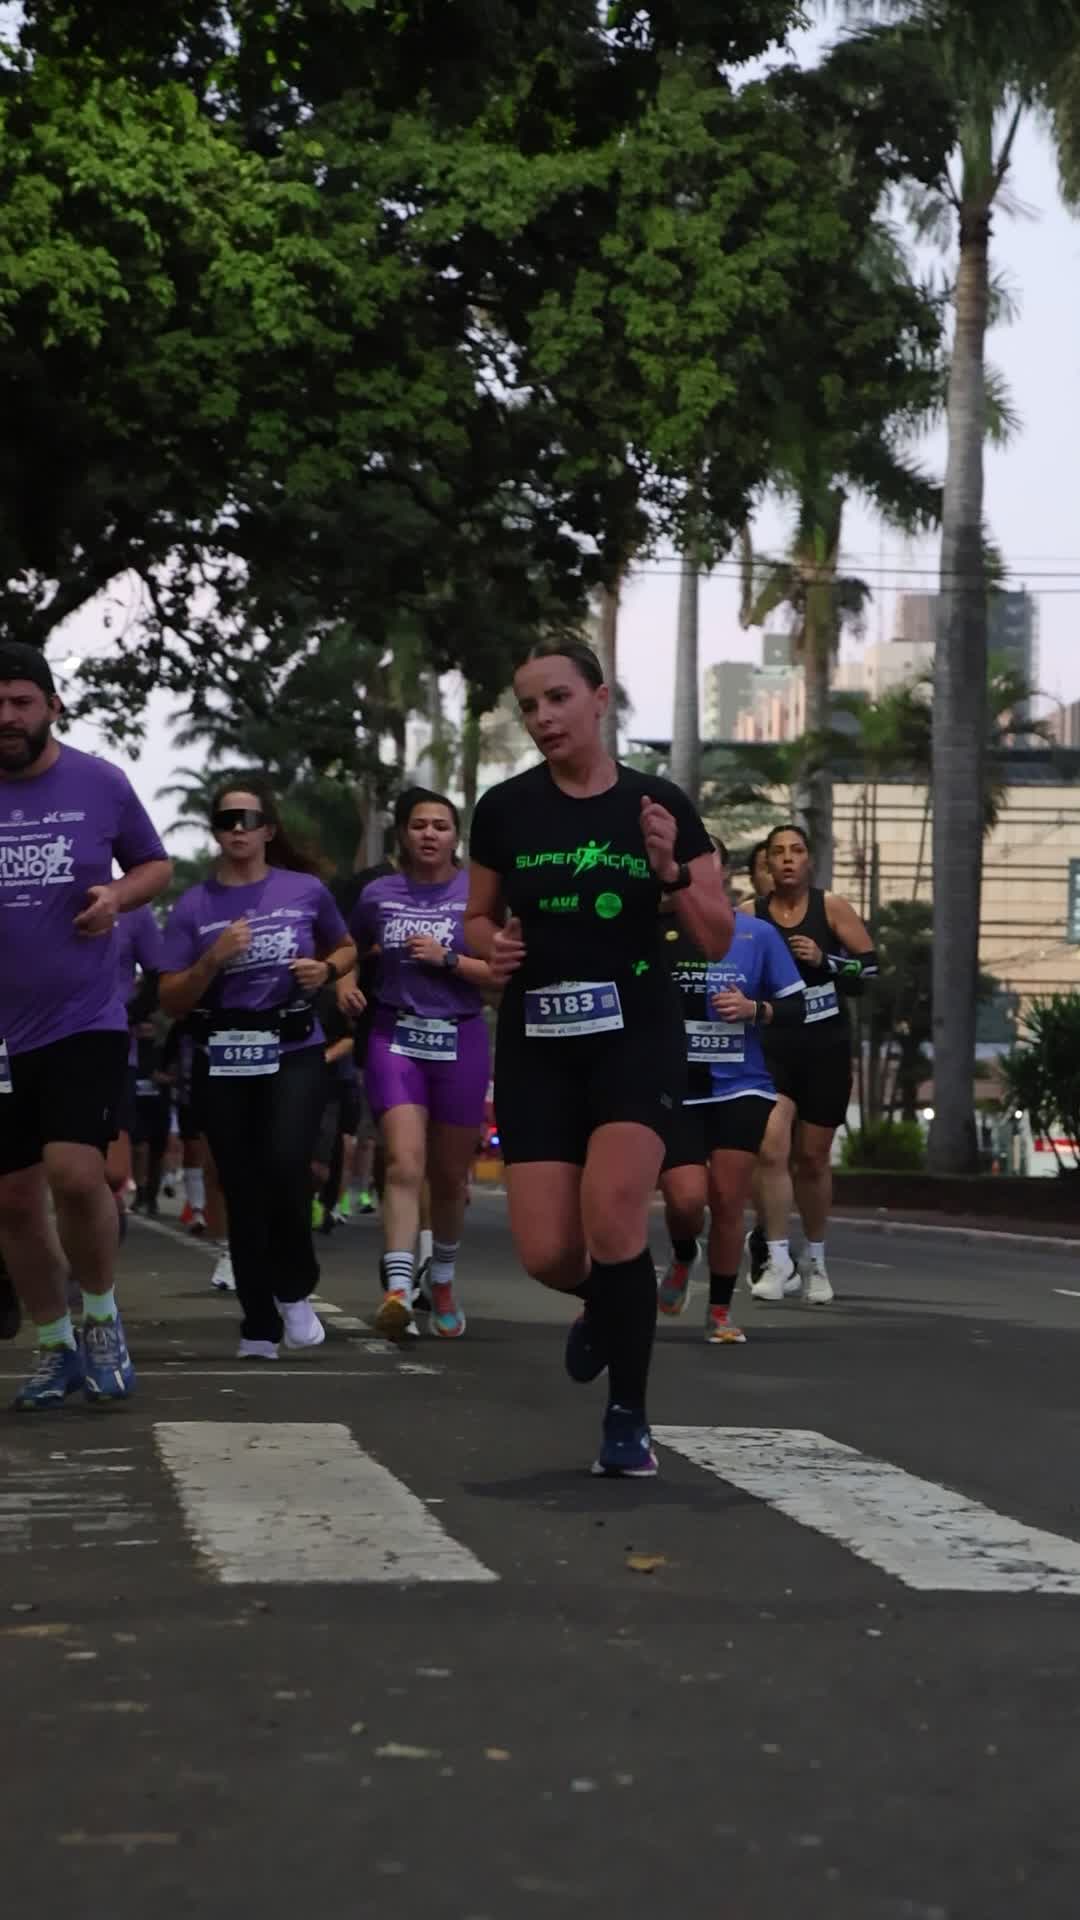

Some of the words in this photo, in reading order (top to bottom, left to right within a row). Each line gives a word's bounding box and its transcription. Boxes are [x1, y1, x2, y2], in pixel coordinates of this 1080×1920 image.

[0, 843, 60, 863] UNDO
[0, 861, 60, 878] LHOR
[671, 972, 747, 983] CARIOCA
[539, 993, 595, 1016] 5183
[806, 997, 825, 1011] 81
[408, 1031, 444, 1046] 5244
[691, 1036, 729, 1048] 5033
[223, 1047, 264, 1060] 6143
